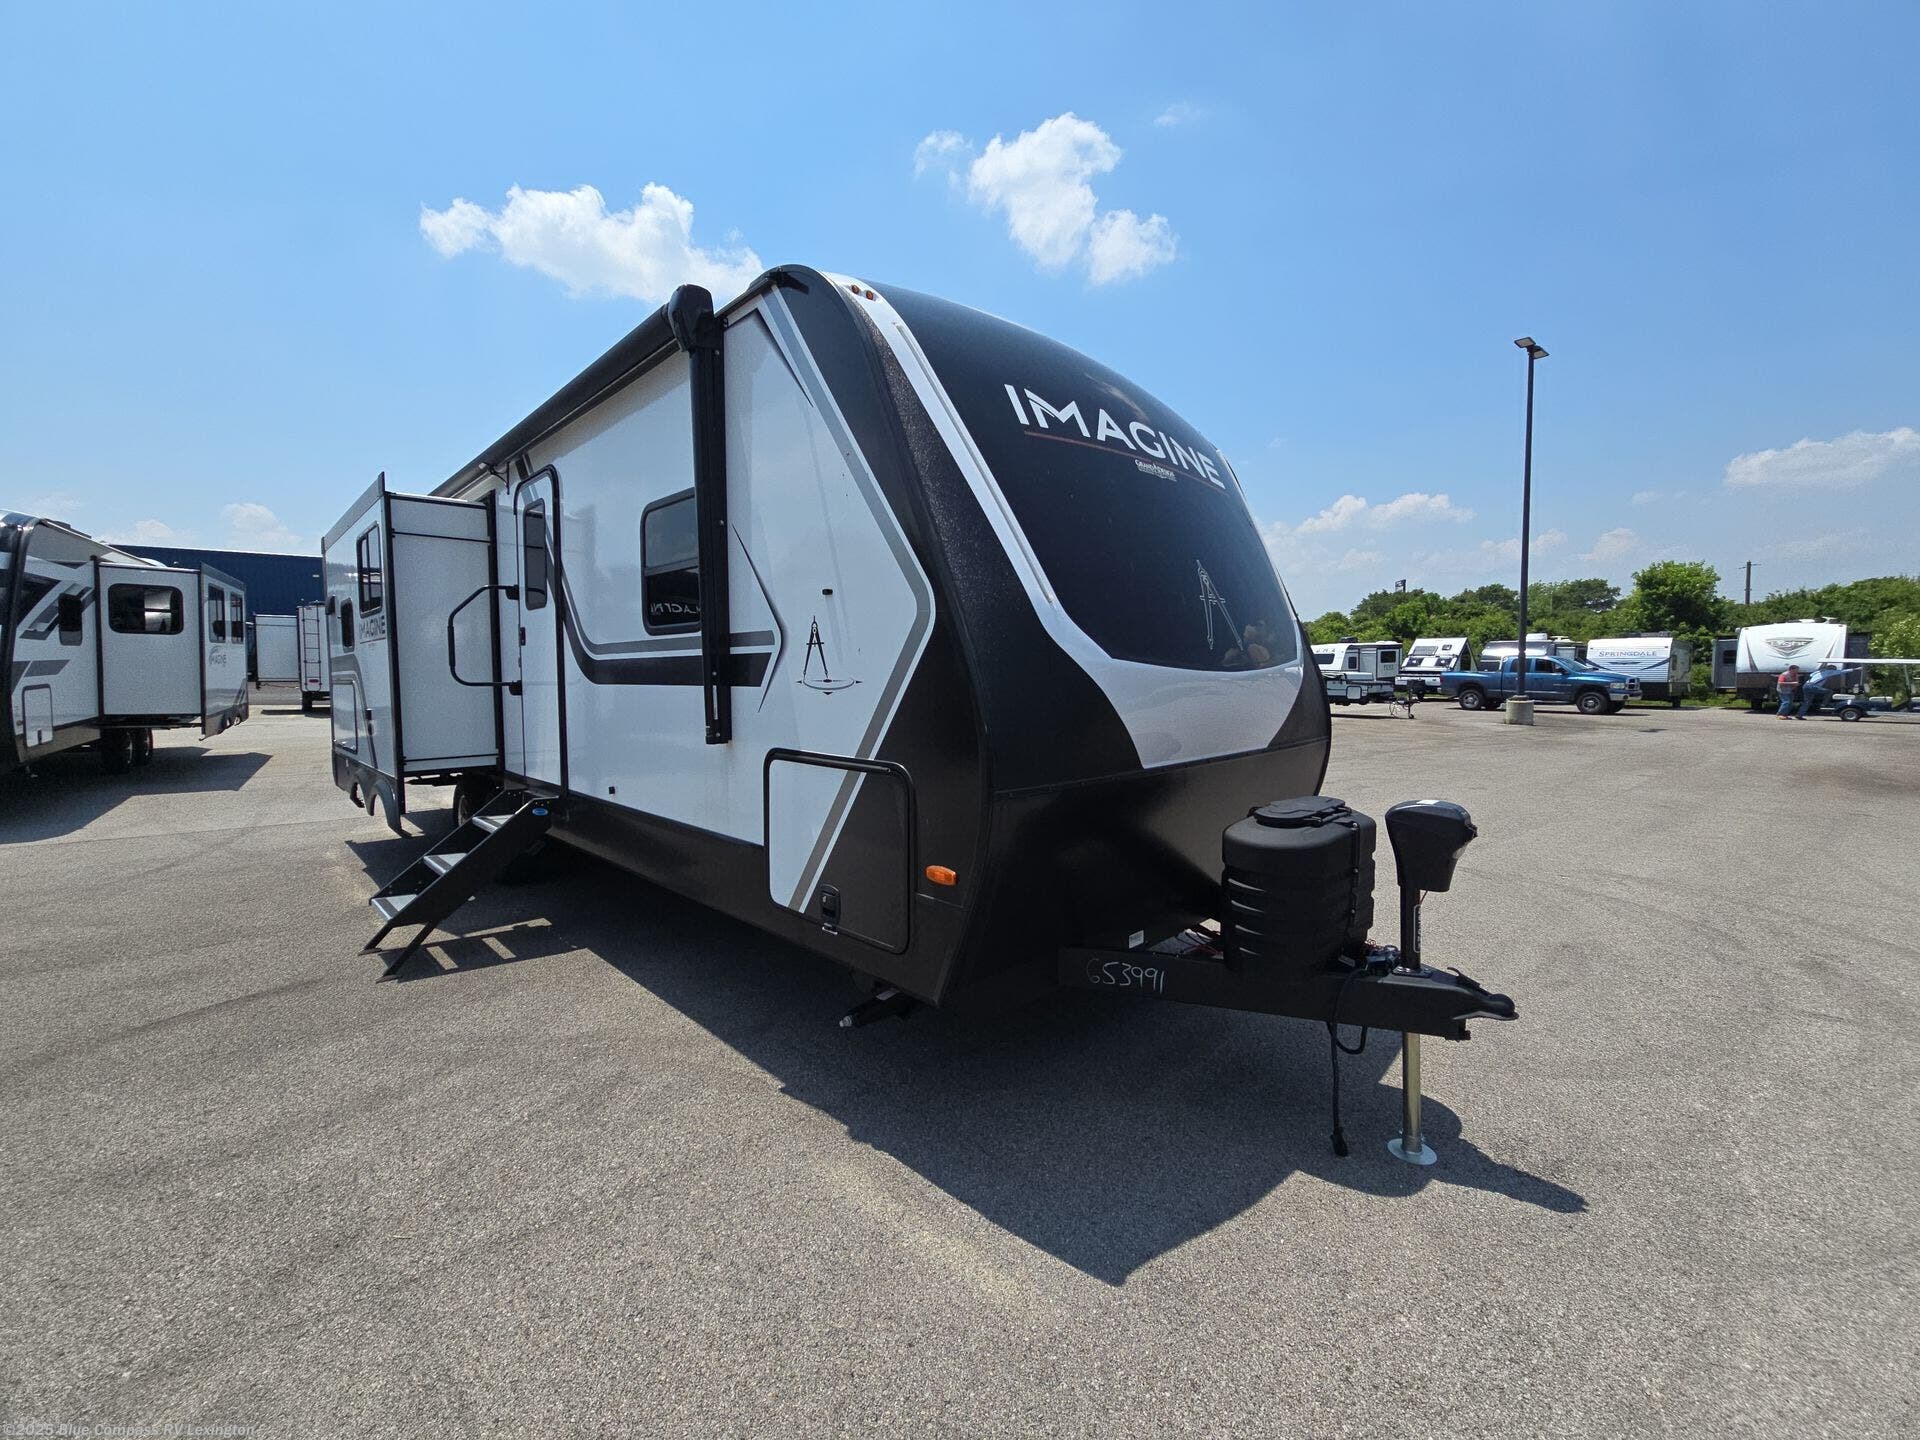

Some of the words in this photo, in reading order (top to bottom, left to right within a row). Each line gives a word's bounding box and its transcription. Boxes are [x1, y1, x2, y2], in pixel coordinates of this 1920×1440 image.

[1004, 384, 1225, 489] IMAGINE
[359, 615, 386, 640] IMAGINE
[1598, 650, 1657, 658] SPRINGDALE
